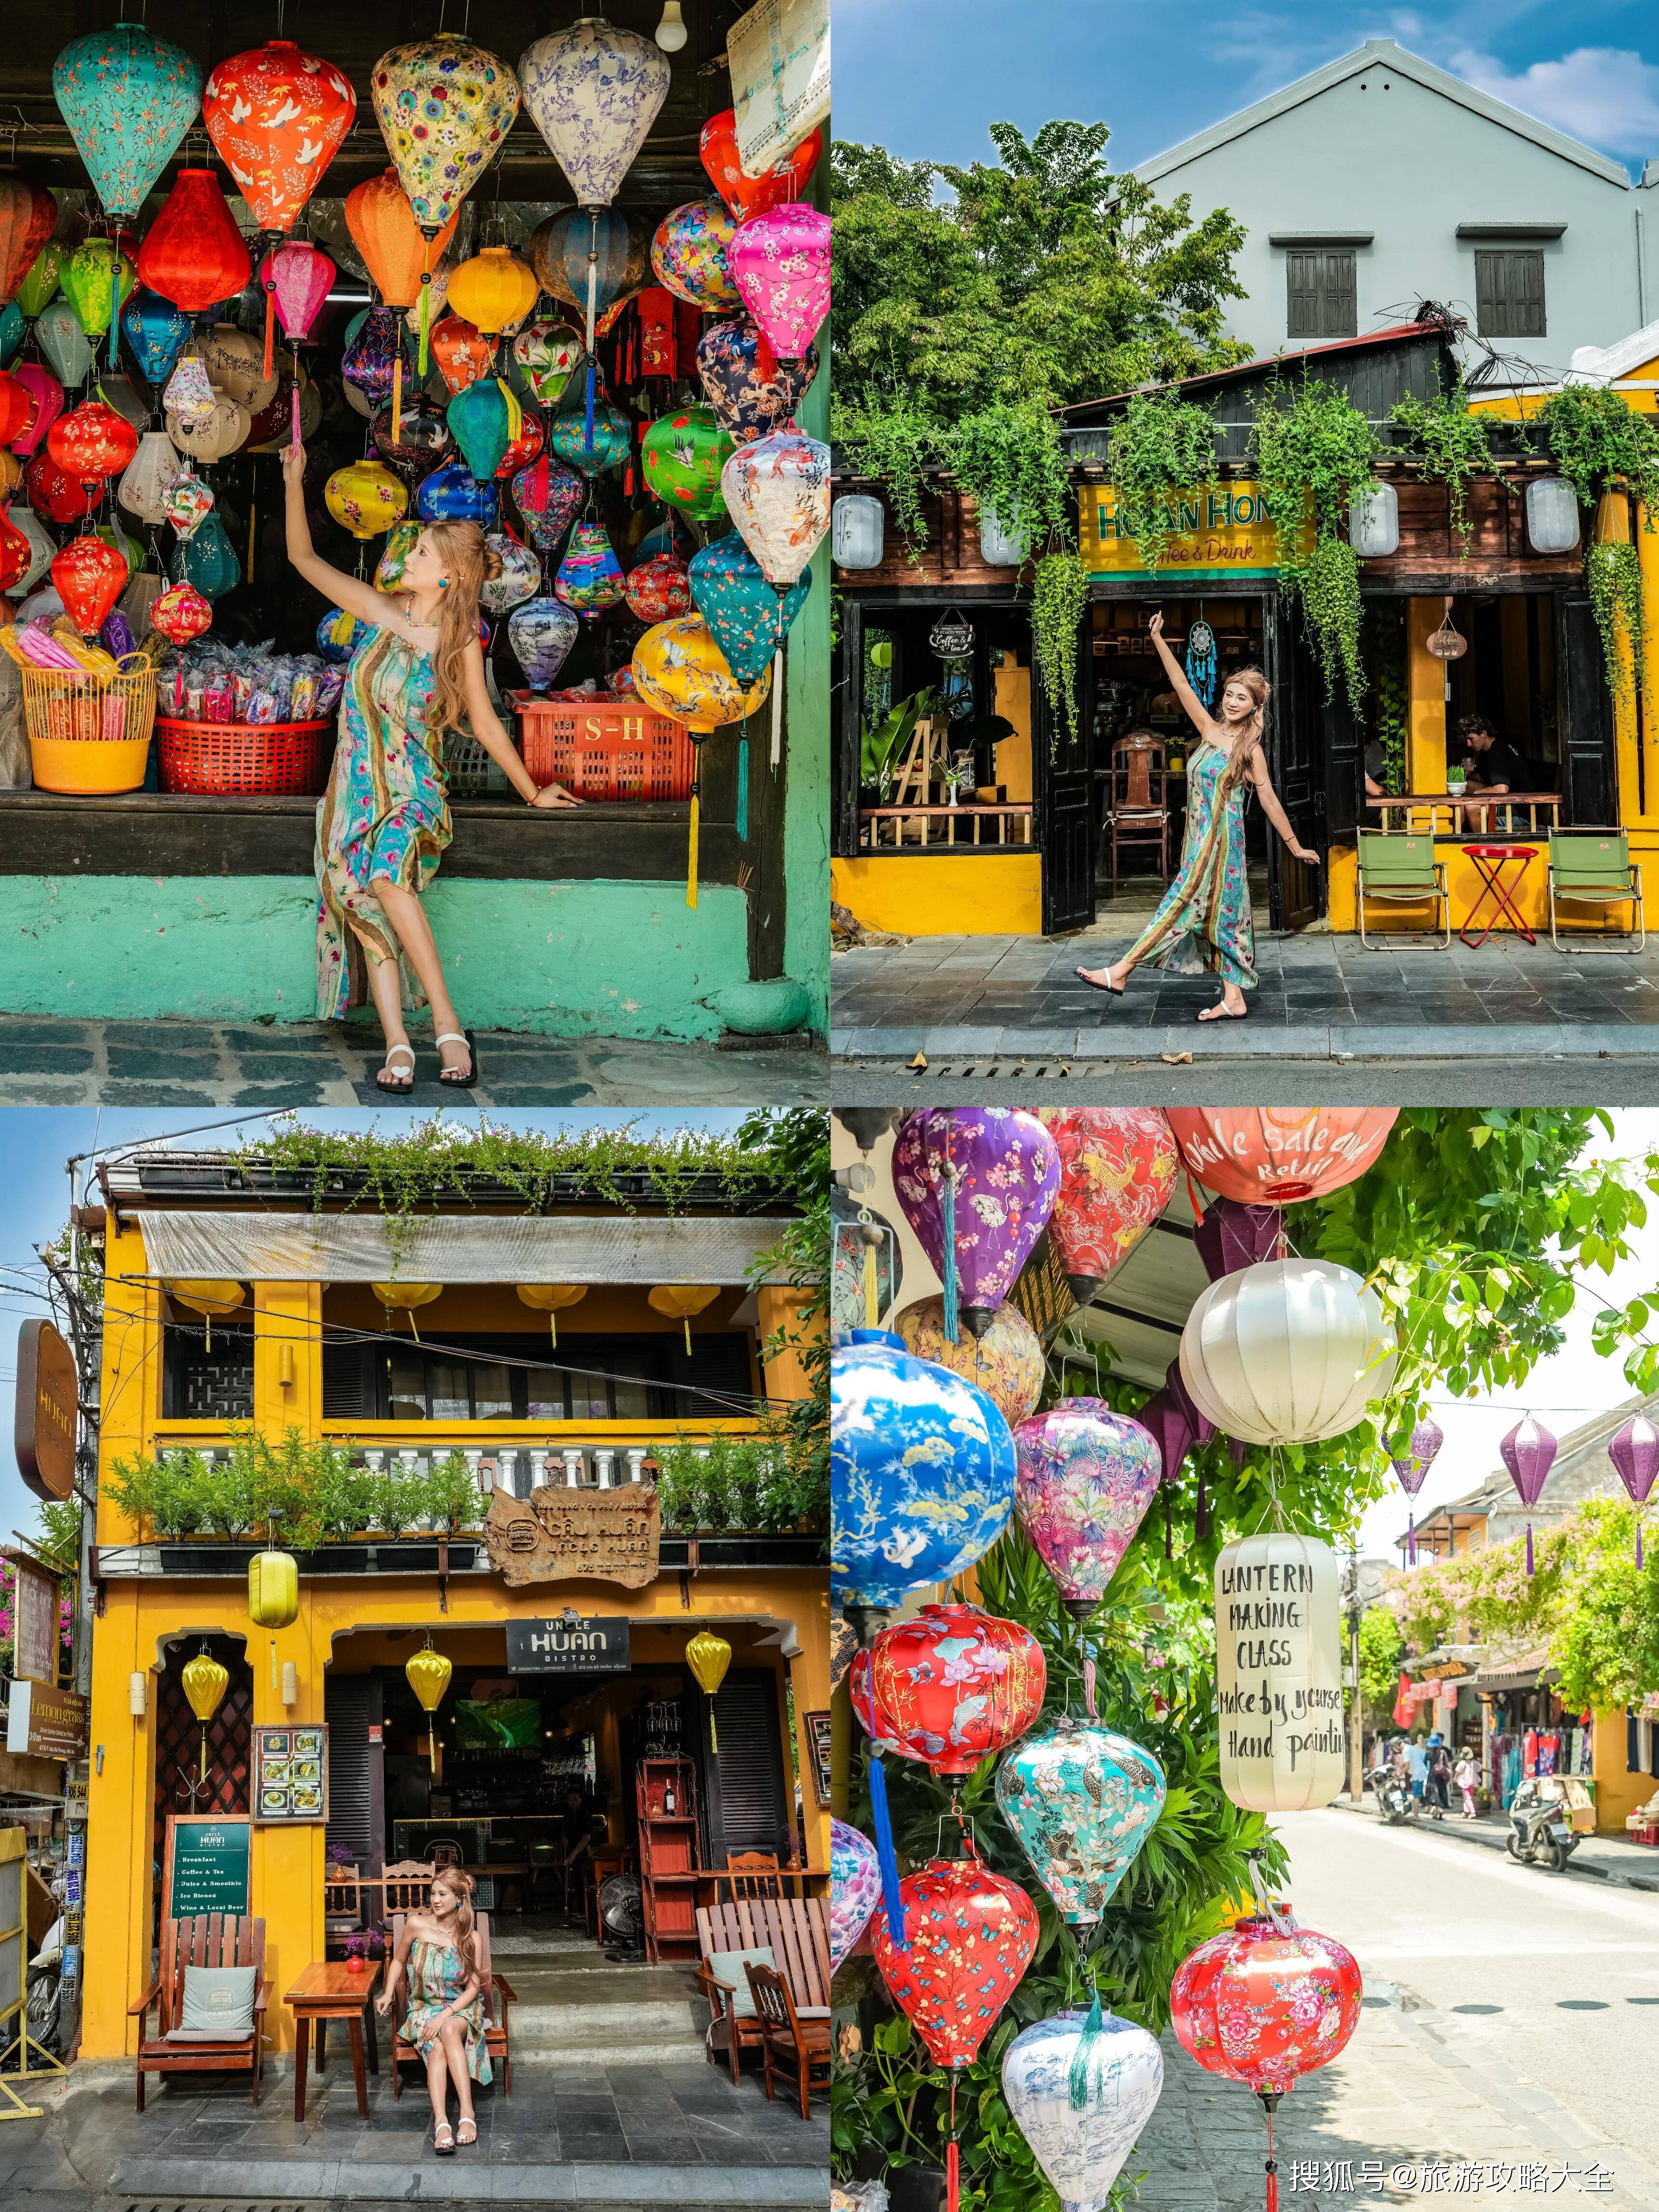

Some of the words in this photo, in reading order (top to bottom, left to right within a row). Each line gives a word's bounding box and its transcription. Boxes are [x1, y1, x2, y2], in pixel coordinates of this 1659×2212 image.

[1193, 545, 1204, 561] &
[1205, 538, 1257, 561] Drink
[937, 635, 959, 646] Coffee
[48, 1371, 67, 1401] UNCLE
[40, 1385, 72, 1438] HUAN
[548, 1542, 598, 1552] UNCLE
[607, 1542, 648, 1552] HUAN
[577, 1562, 595, 1572] 675
[1222, 1564, 1312, 1594] LANTERN
[531, 1632, 606, 1652] HUAN
[1237, 1639, 1292, 1669] CLASS
[1220, 1682, 1257, 1714] Make
[1259, 1679, 1288, 1727] by
[29, 1732, 41, 1742] 30m
[1228, 1719, 1277, 1759] Hand
